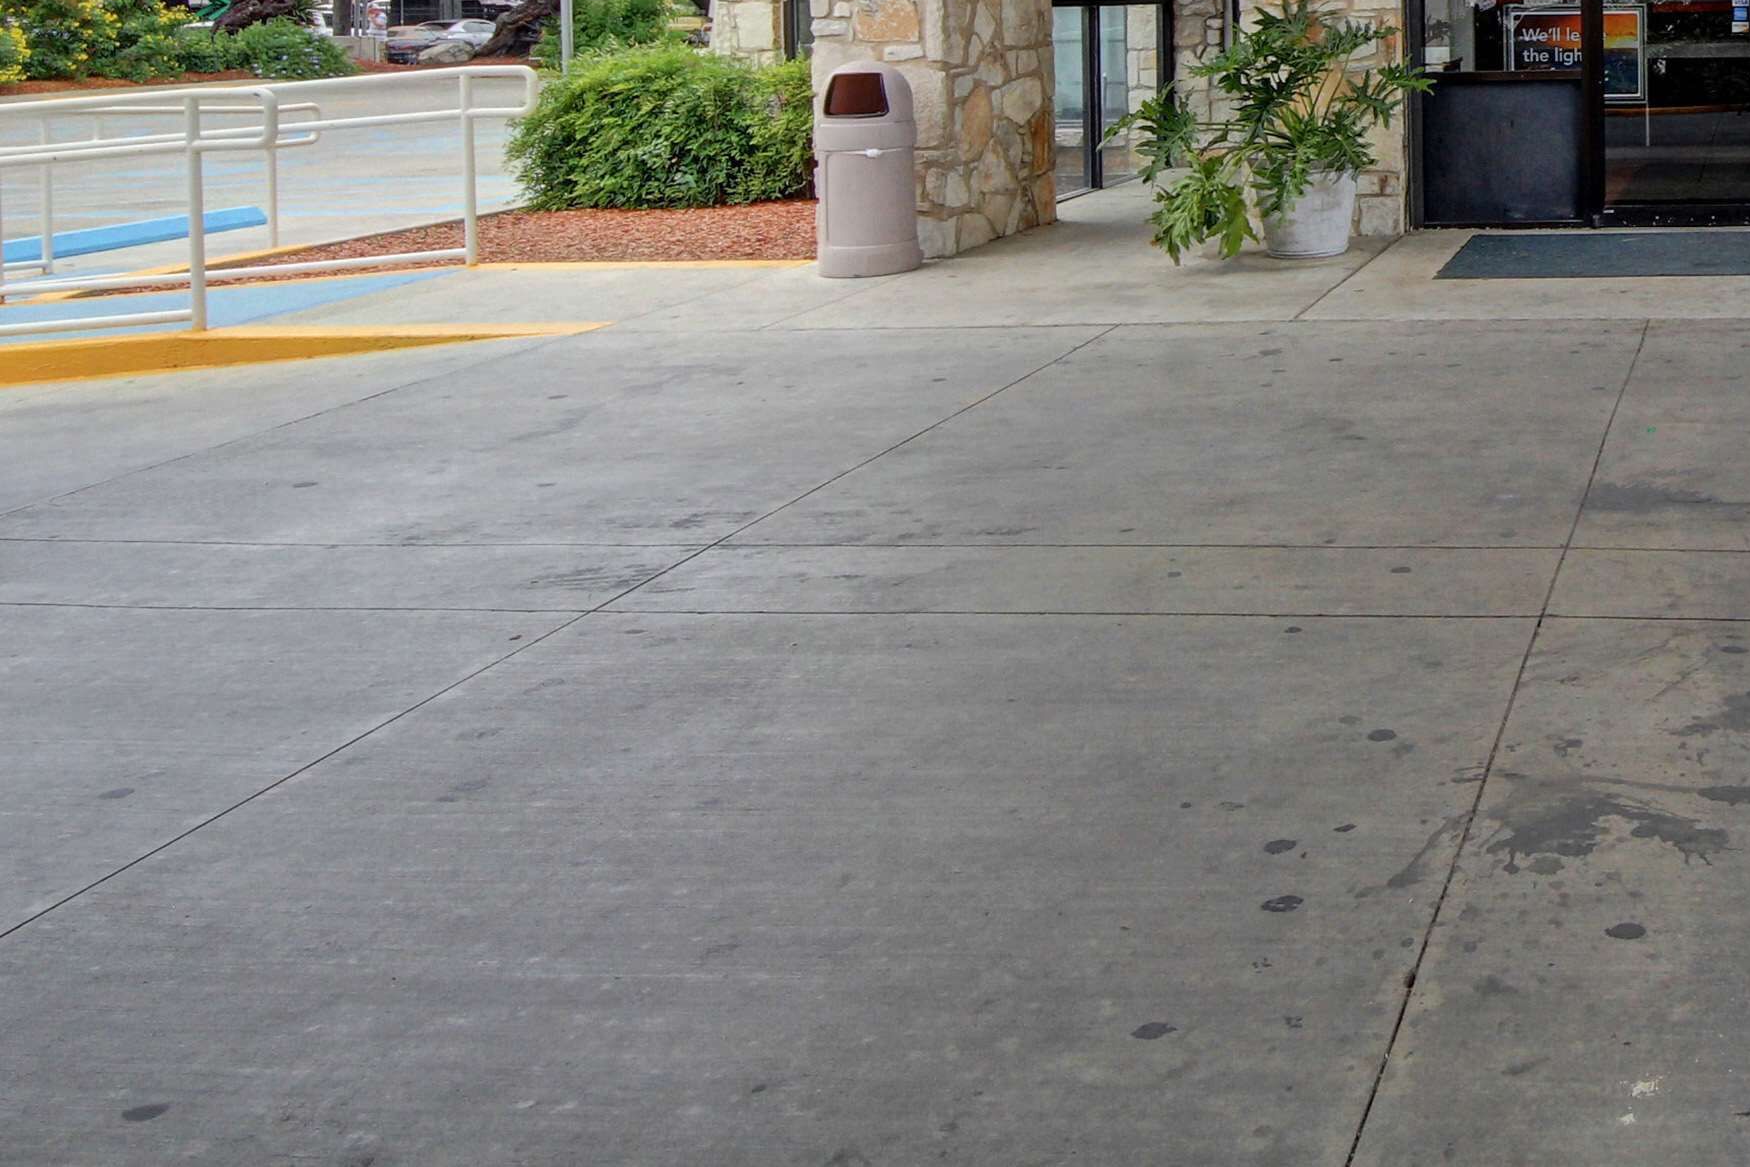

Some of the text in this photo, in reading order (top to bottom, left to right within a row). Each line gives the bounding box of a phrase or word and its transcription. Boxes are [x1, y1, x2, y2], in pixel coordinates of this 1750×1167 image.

[1521, 27, 1561, 42] We'll
[1522, 47, 1582, 65] the ligh
